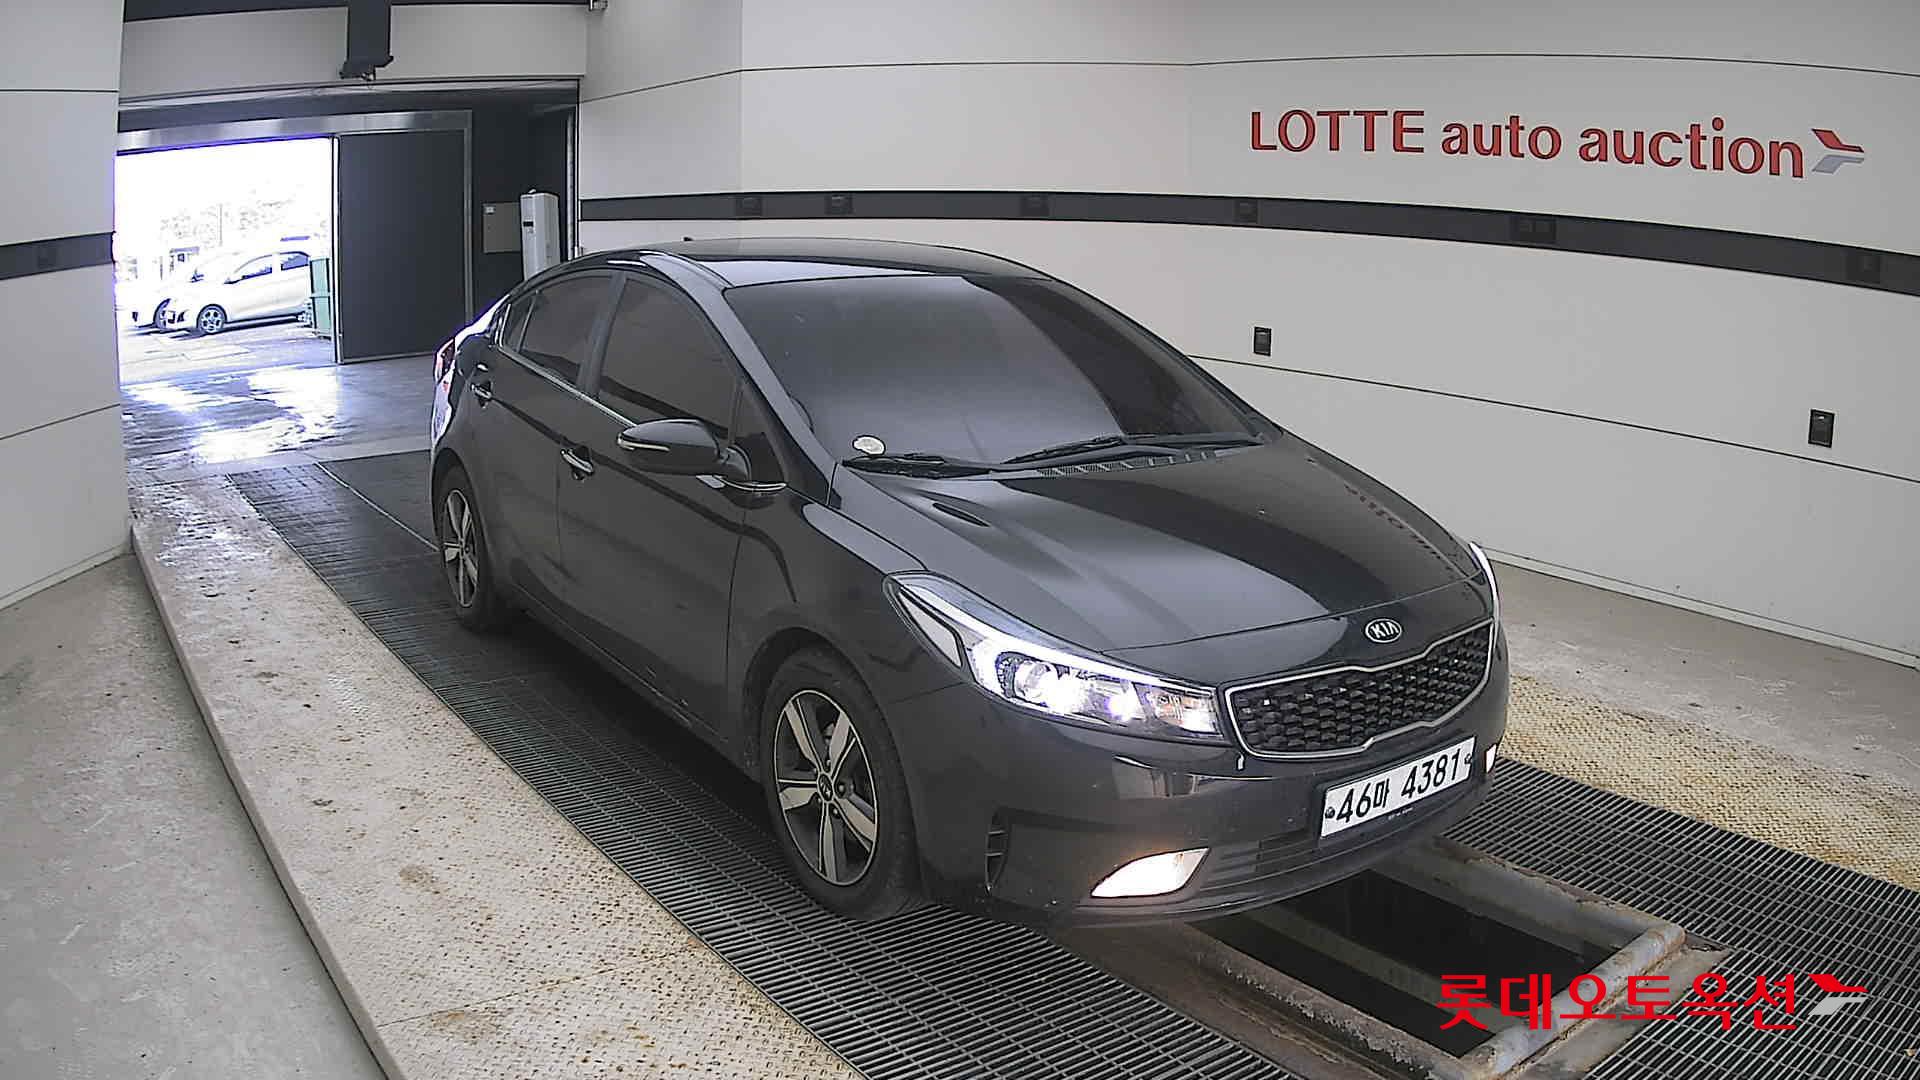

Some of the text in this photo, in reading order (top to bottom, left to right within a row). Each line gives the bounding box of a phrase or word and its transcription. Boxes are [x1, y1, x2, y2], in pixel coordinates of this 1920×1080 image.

[1251, 110, 1805, 179] LOTTE auto auction
[1370, 621, 1400, 639] KIA
[1336, 748, 1462, 823] 46마 4381
